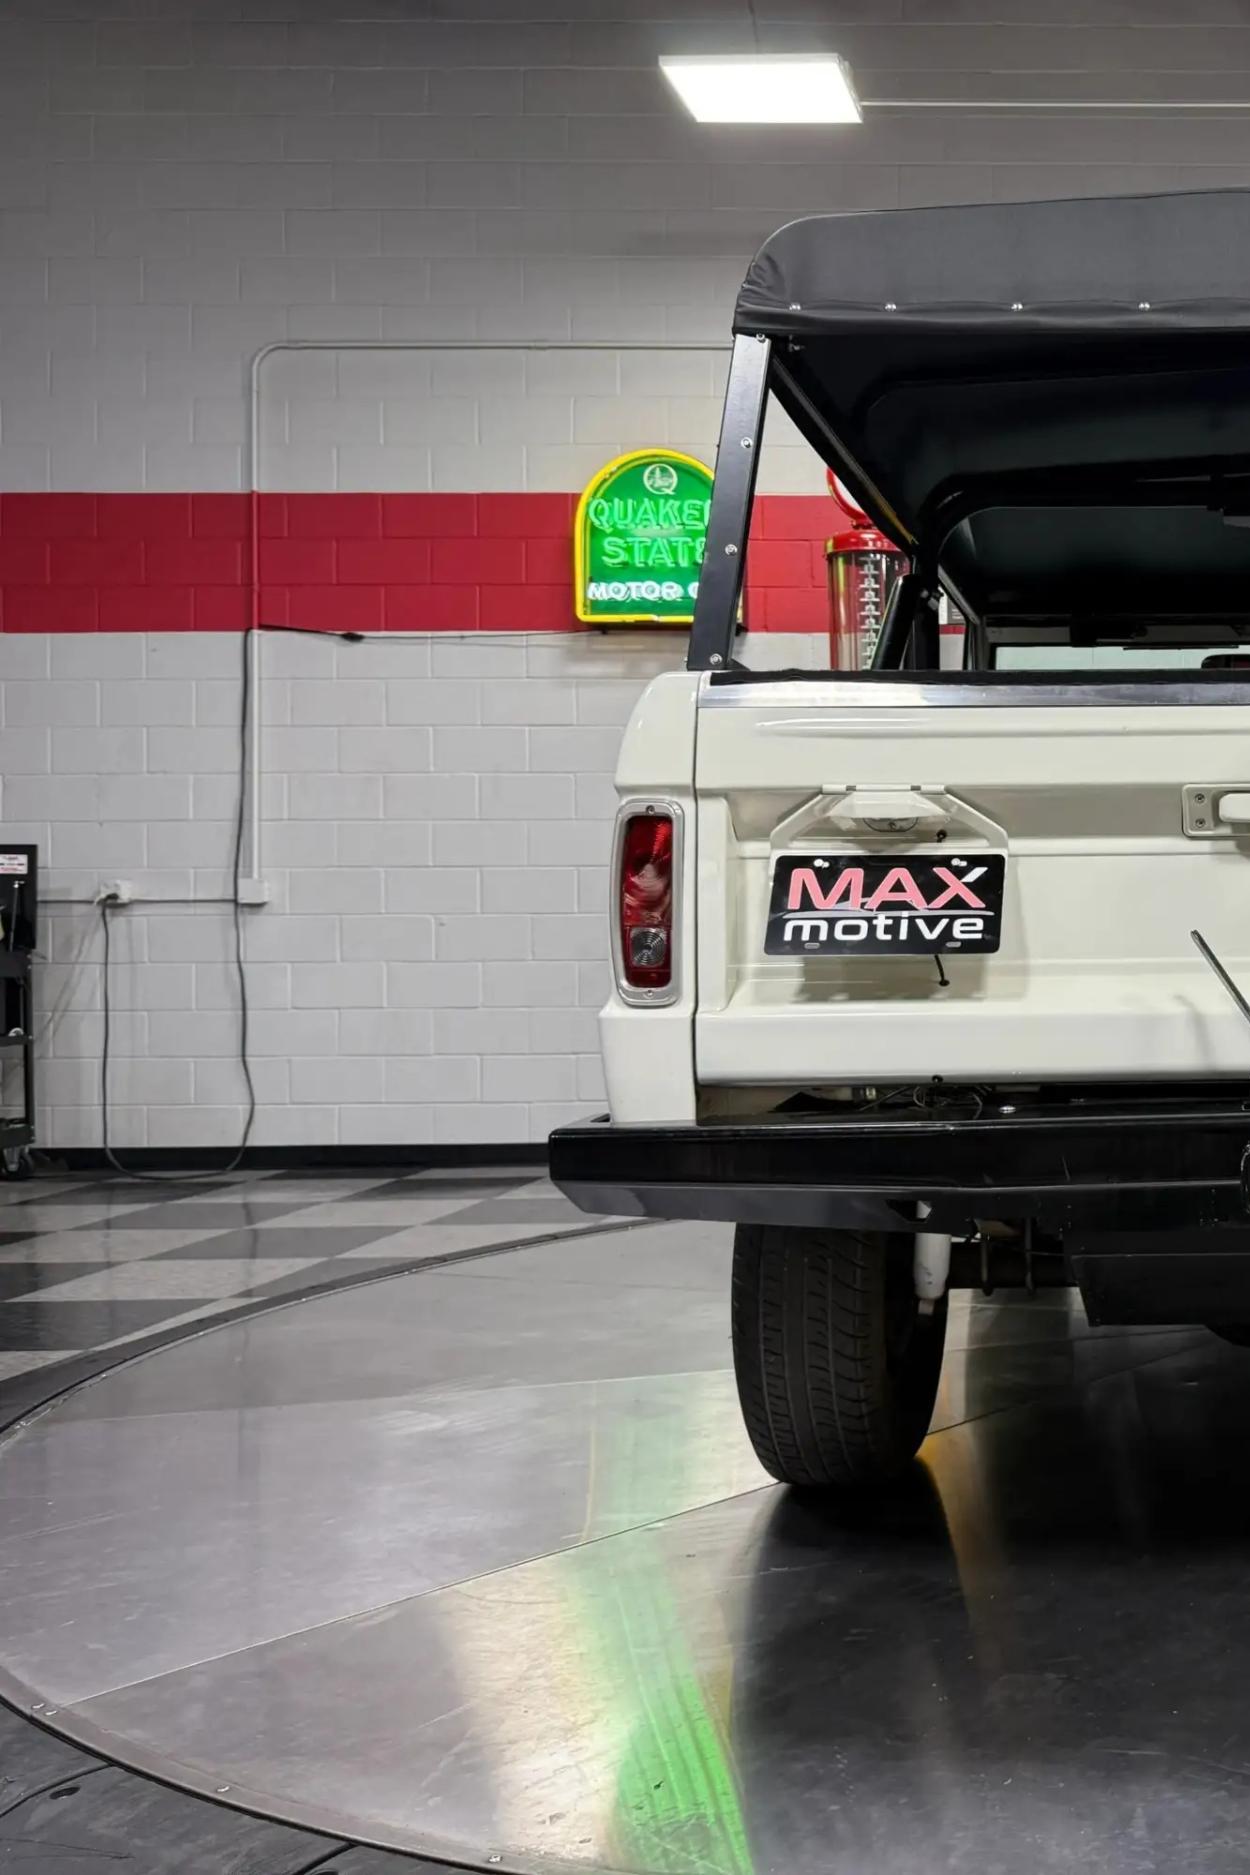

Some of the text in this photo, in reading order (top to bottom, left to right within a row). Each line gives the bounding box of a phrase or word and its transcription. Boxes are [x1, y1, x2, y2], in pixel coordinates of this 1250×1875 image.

[587, 581, 684, 602] MOTOR
[787, 867, 988, 910] MAX
[783, 911, 985, 941] motive
